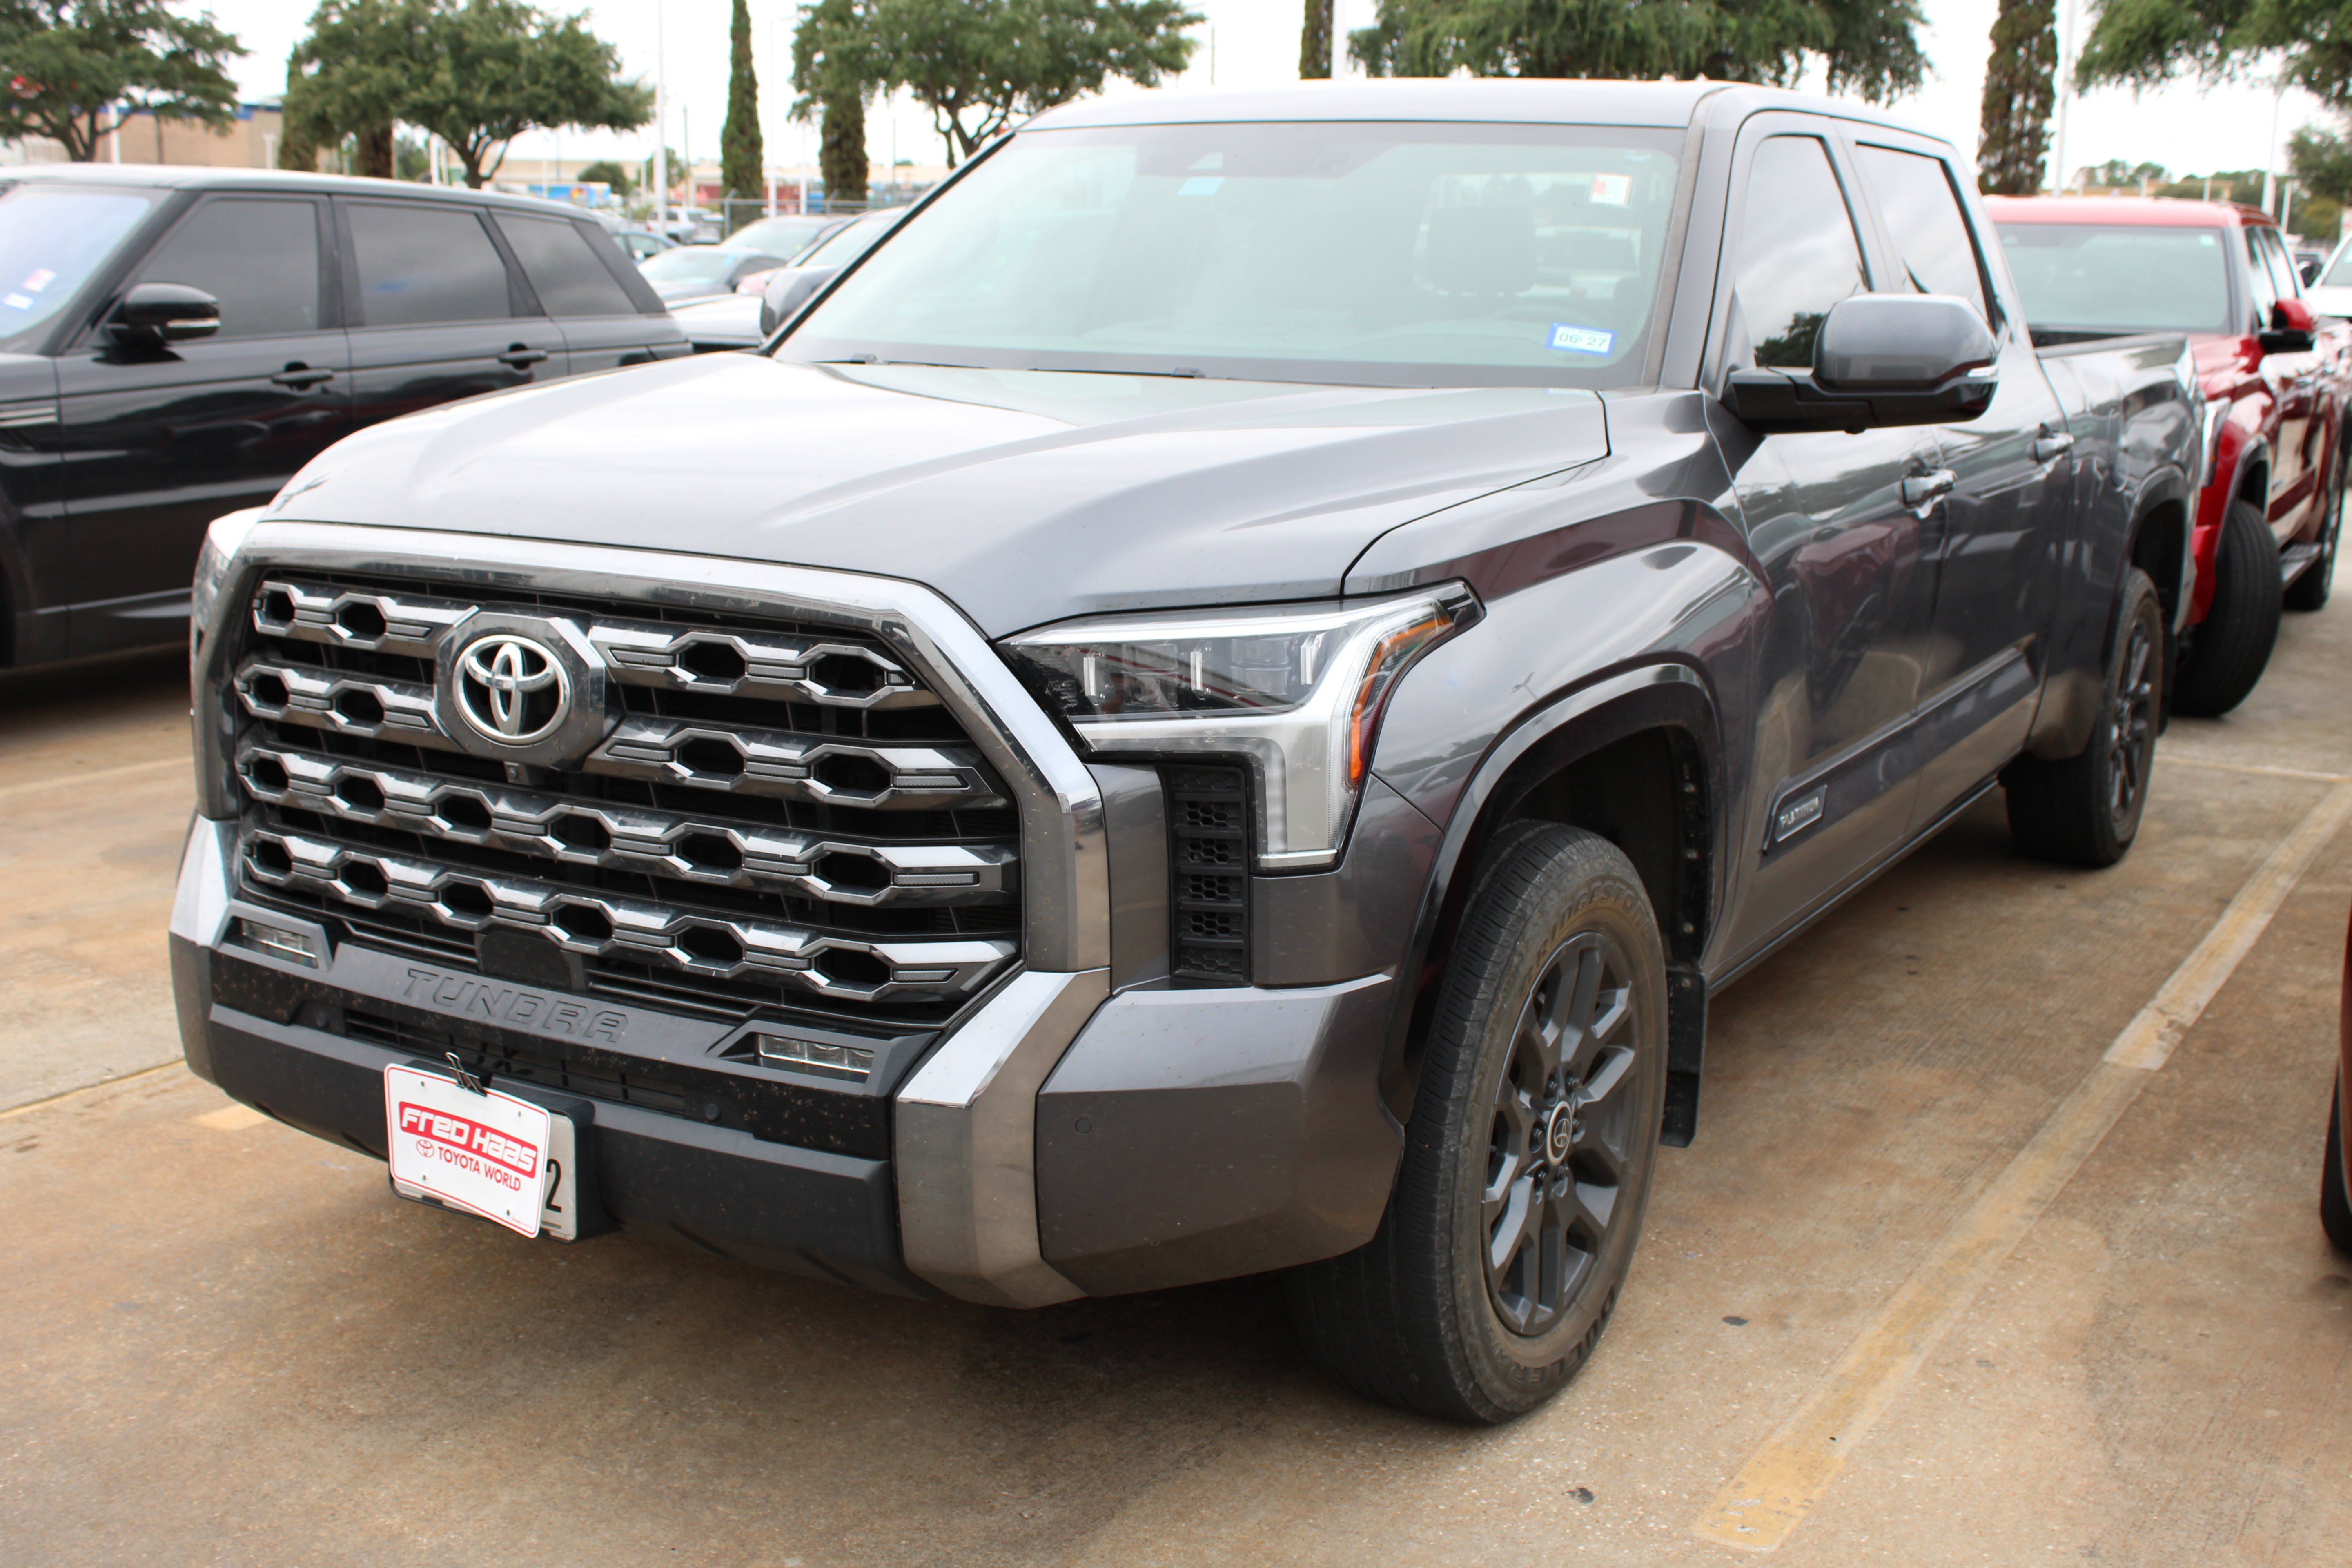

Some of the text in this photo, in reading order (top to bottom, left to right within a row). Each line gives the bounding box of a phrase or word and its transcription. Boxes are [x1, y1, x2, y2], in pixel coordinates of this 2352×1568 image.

[1559, 333, 1578, 343] 06
[1586, 336, 1607, 347] 27
[403, 968, 628, 1043] TUNDRA
[438, 1146, 521, 1192] TOYOTA WORLD
